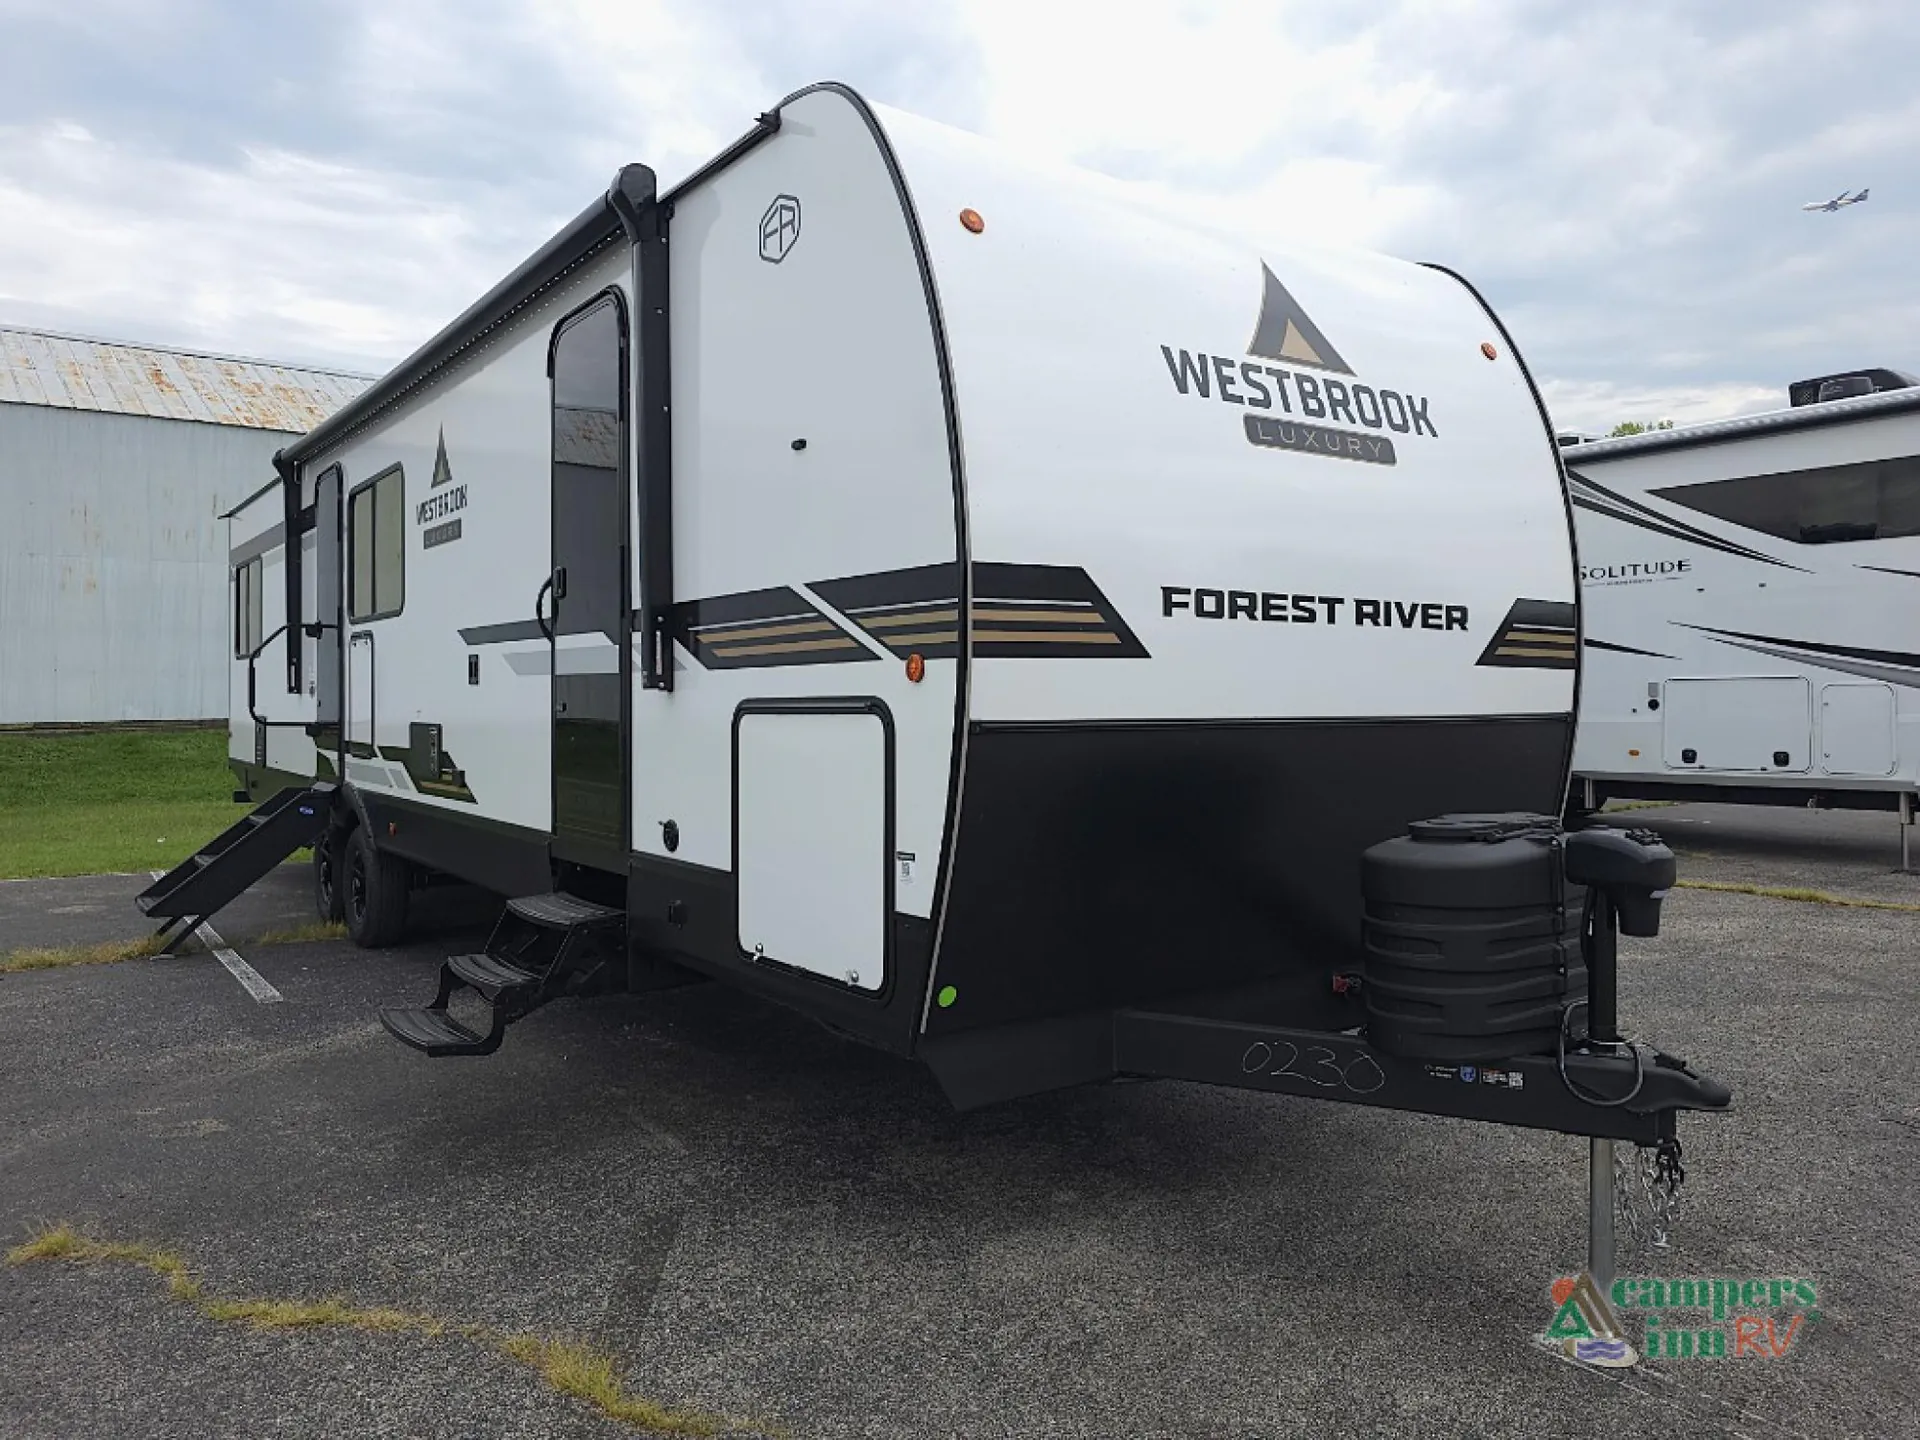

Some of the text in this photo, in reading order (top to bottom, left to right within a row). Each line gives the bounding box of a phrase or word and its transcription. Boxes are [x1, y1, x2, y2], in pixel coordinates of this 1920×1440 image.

[1160, 344, 1438, 438] WESTBROOK
[1255, 420, 1384, 458] LUXURY
[416, 483, 468, 526] WESTBROOK
[1580, 559, 1692, 580] SOLITUDE
[1160, 586, 1469, 631] FOREST RIVER
[1242, 1041, 1384, 1093] 0230
